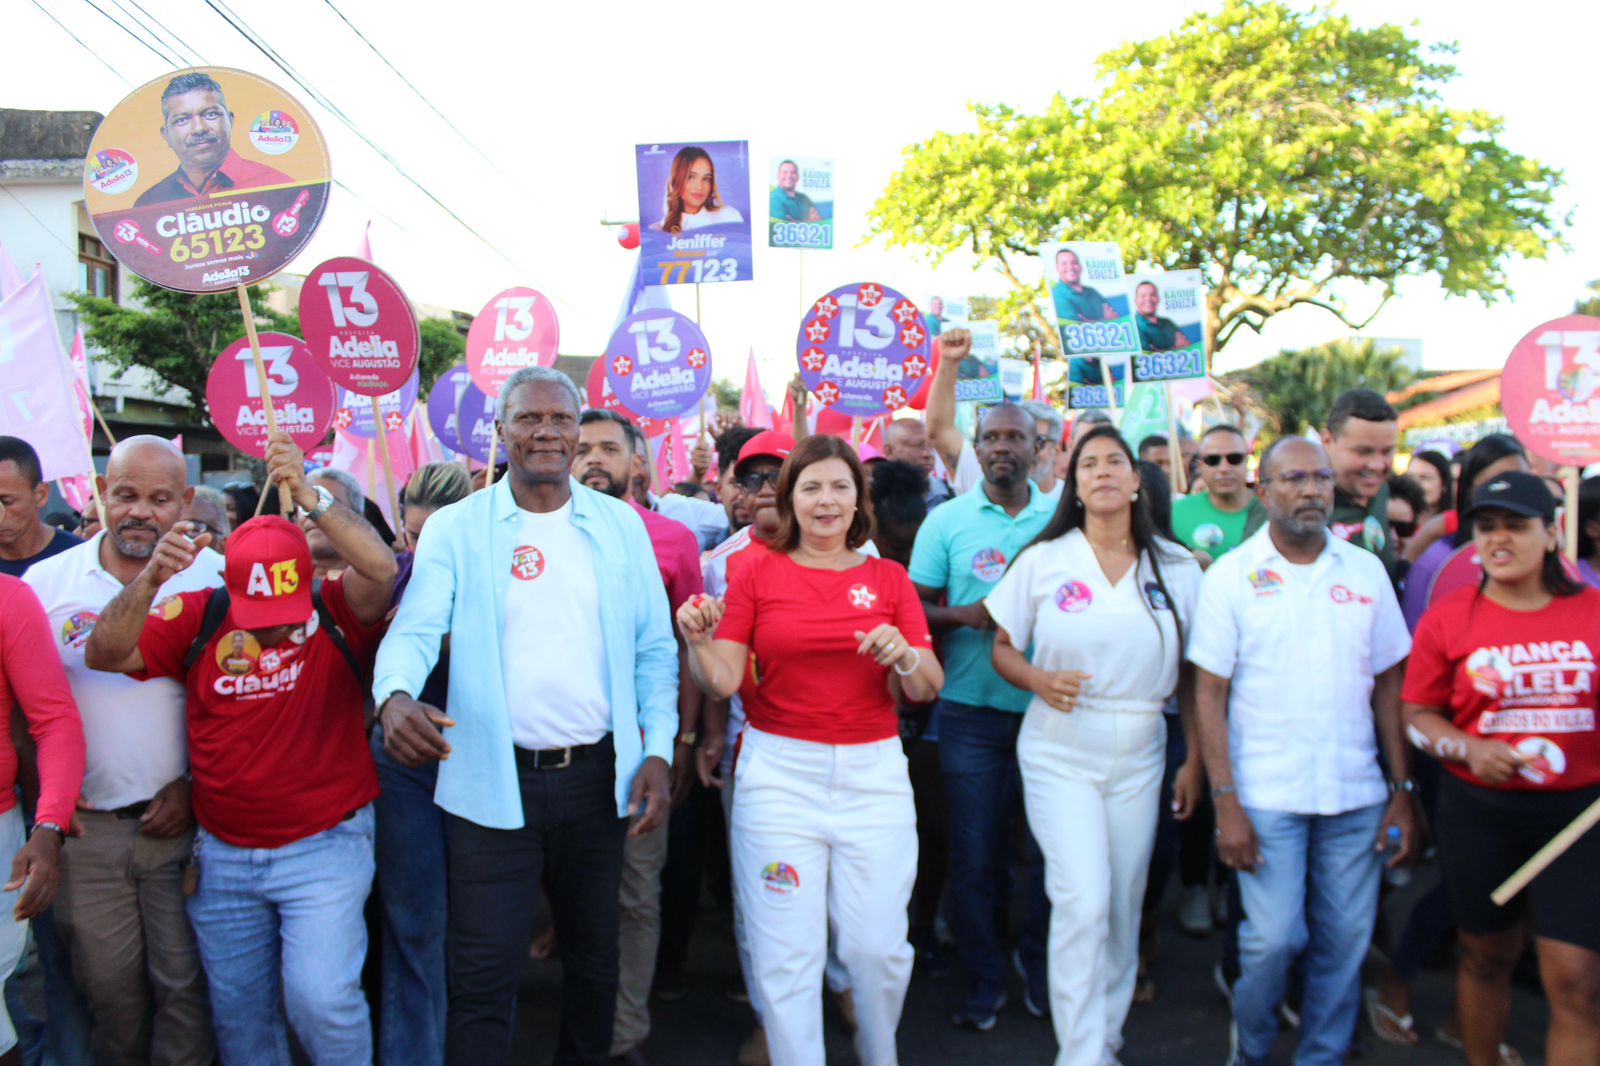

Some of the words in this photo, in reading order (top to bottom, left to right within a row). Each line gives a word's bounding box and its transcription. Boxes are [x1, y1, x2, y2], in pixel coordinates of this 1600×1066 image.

[156, 201, 270, 238] Cláudio
[170, 224, 266, 263] 65123
[666, 233, 727, 251] Jeniffer
[773, 222, 831, 245] 36321
[202, 266, 250, 283] Adelia13
[658, 258, 738, 284] 77123
[318, 271, 380, 328] 13
[493, 295, 538, 342] 13
[837, 294, 897, 350] 13
[329, 335, 399, 358] Adelia
[628, 316, 681, 366] 13
[1064, 322, 1136, 351] 36321
[330, 360, 350, 368] VICE
[352, 358, 401, 368] AUGUSTÃO
[481, 347, 539, 367] Adelia
[821, 354, 903, 381] Adelia
[1137, 350, 1201, 379] 36321
[234, 345, 299, 398] 13
[631, 367, 695, 392] Adelia
[1071, 384, 1122, 408] 3631
[236, 427, 259, 435] VICE
[261, 424, 315, 435] AGUSTÃO
[246, 559, 299, 597] A13
[1489, 640, 1593, 663] VANÇA
[1504, 670, 1592, 696] LELA
